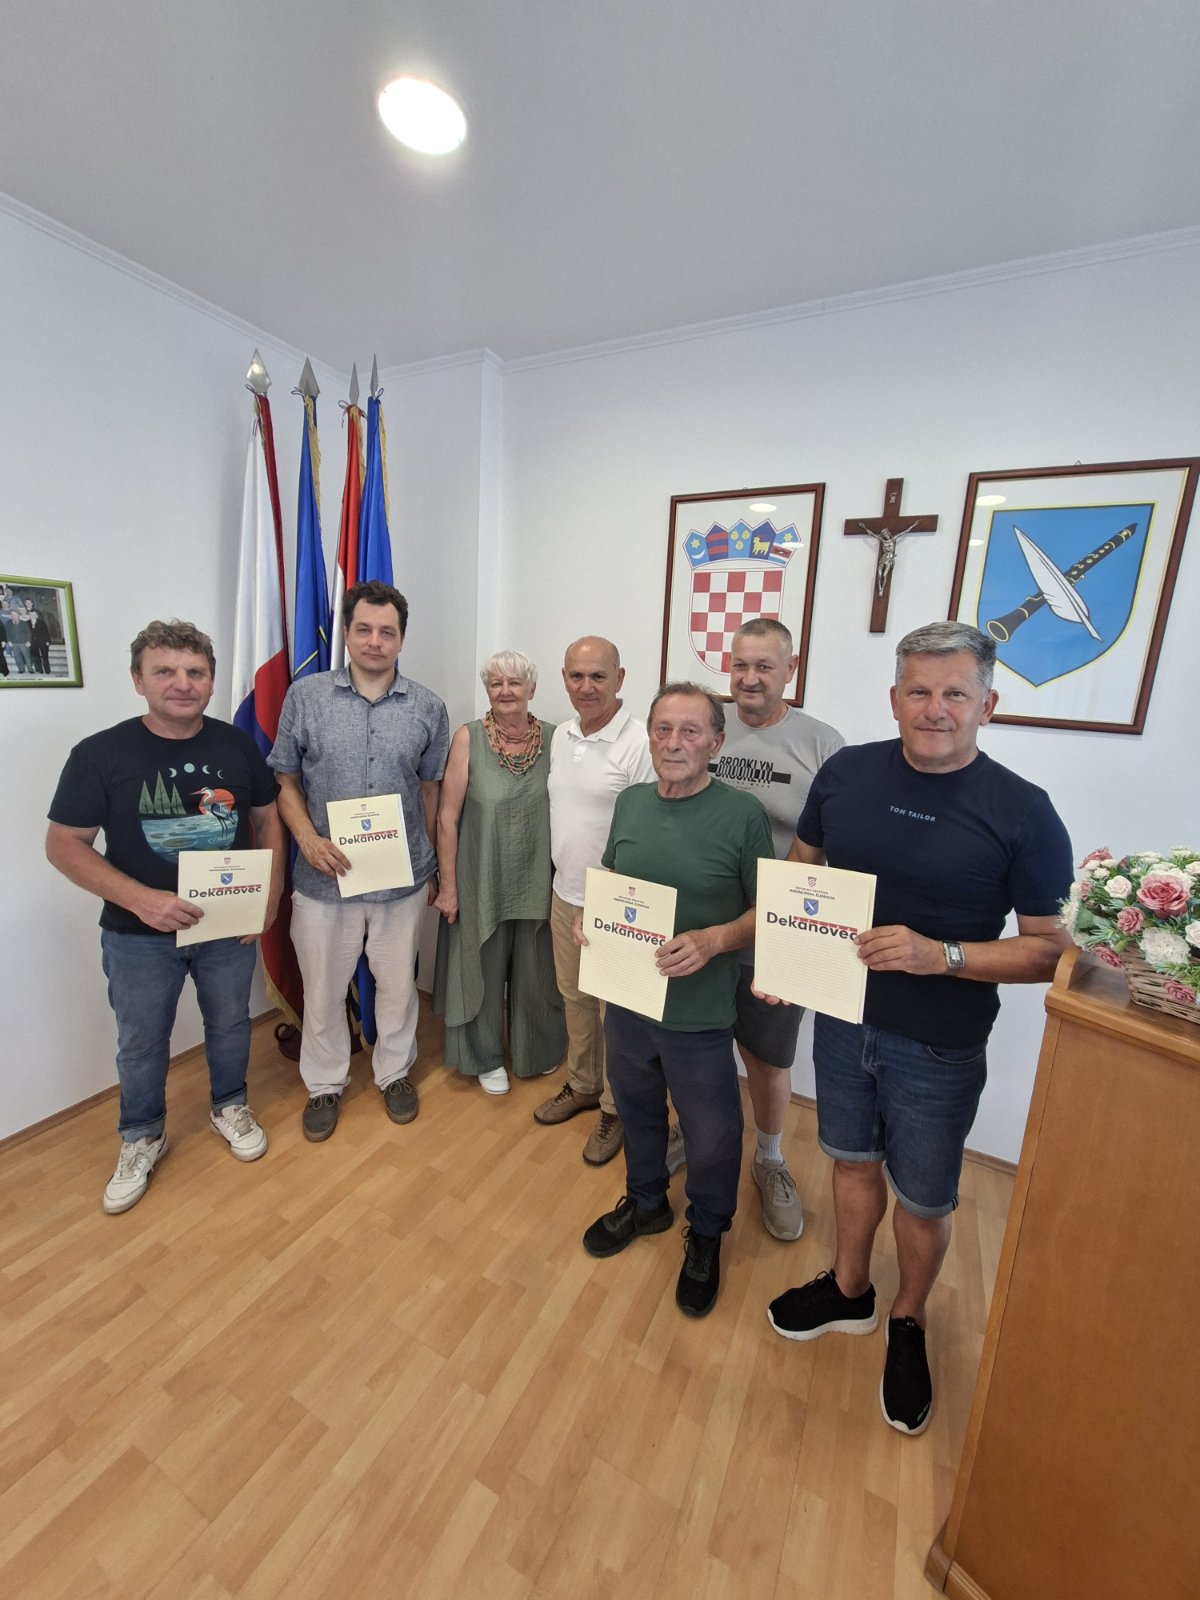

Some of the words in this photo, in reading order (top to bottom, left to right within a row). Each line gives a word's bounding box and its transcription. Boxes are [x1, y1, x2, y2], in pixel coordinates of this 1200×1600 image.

[890, 805, 906, 815] TOM
[908, 811, 936, 822] TAILOR
[339, 832, 399, 846] Dekanovec
[189, 885, 262, 898] Dekanovec
[594, 917, 666, 947] Dekanovec
